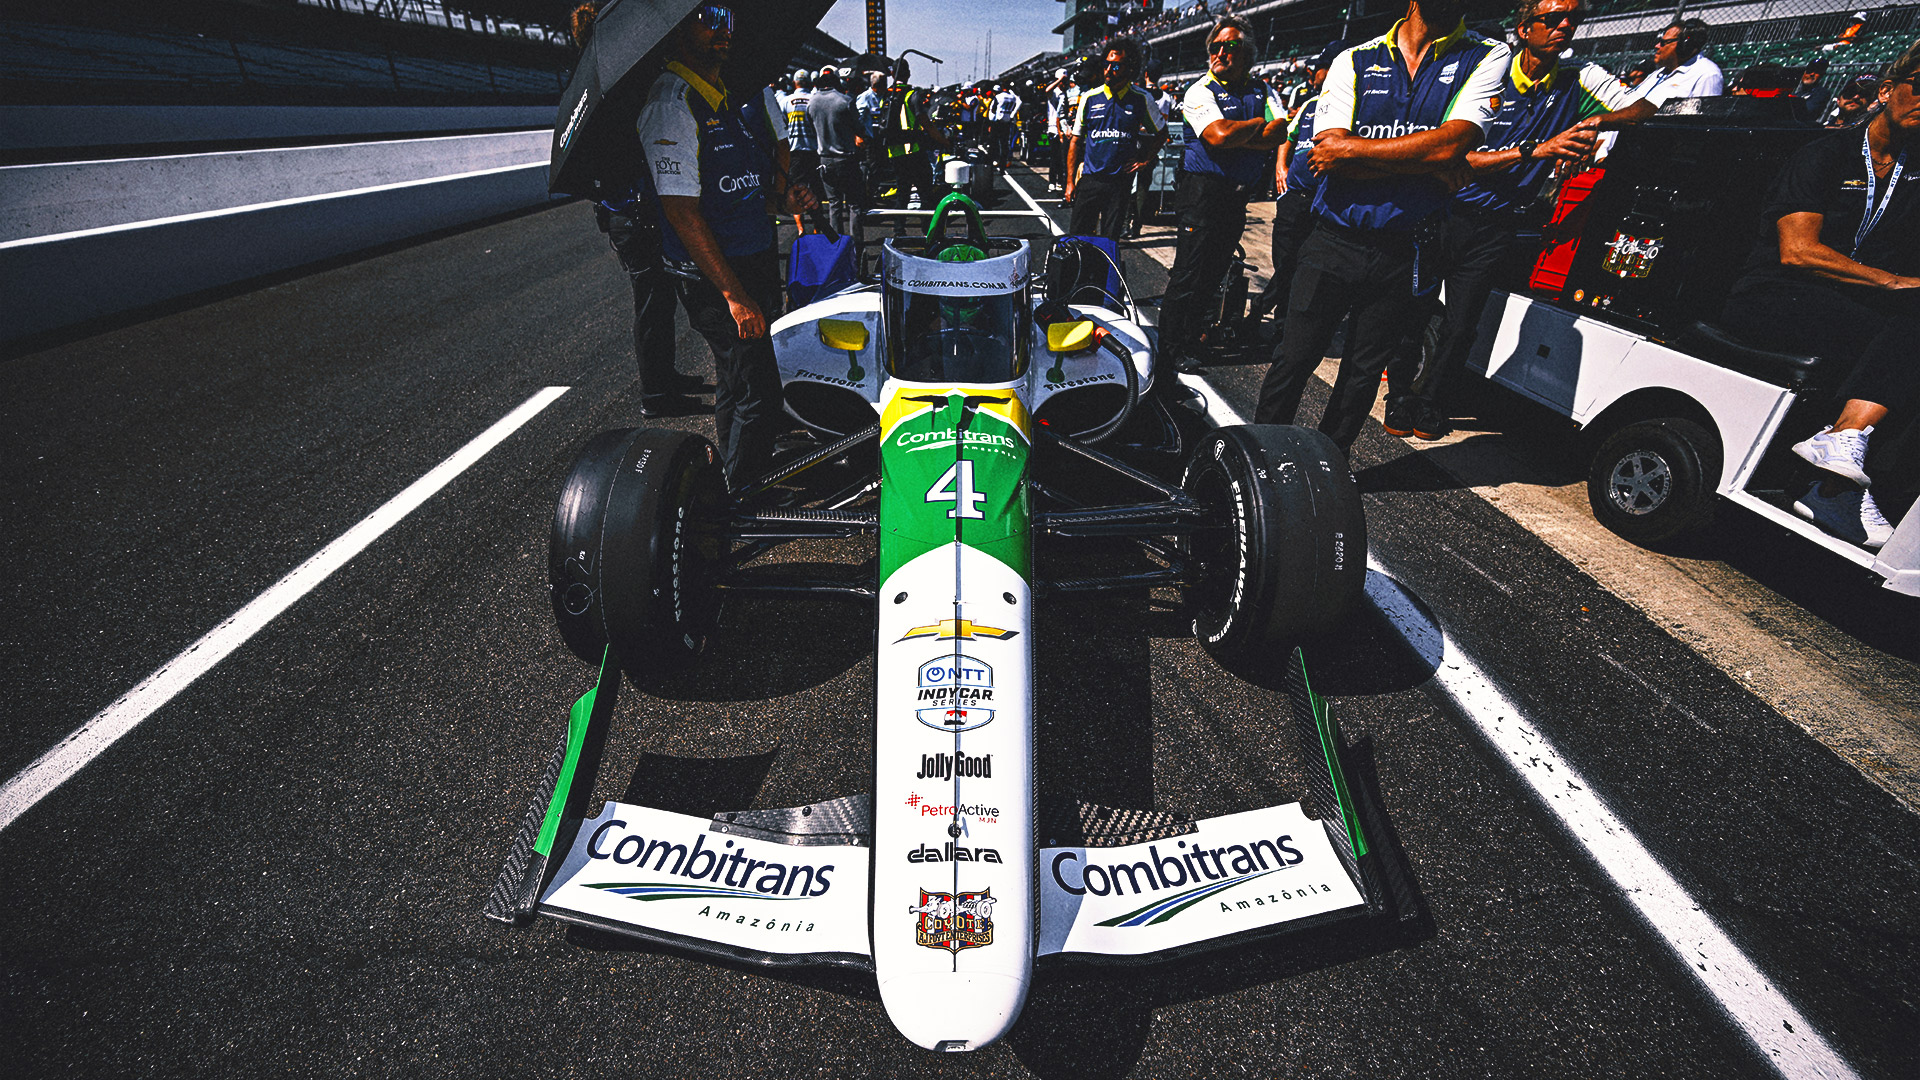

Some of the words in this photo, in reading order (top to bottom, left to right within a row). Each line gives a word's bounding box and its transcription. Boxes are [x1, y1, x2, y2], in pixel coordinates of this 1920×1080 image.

[655, 160, 681, 171] FOYT
[794, 369, 866, 389] Firestone
[1043, 373, 1116, 392] Firestone
[896, 428, 1015, 449] Combitrans
[924, 459, 987, 520] 4
[1231, 480, 1247, 611] FIREHAWK
[948, 667, 985, 681] NTT
[917, 687, 994, 701] INDYCAR
[921, 803, 1000, 817] PetroActive
[586, 819, 835, 897] Combitrans
[907, 842, 1003, 864] dallara
[1051, 834, 1304, 897] Combitrans
[1220, 881, 1332, 913] Amazônia
[698, 905, 816, 933] Amazônia
[924, 915, 985, 930] COYOTE
